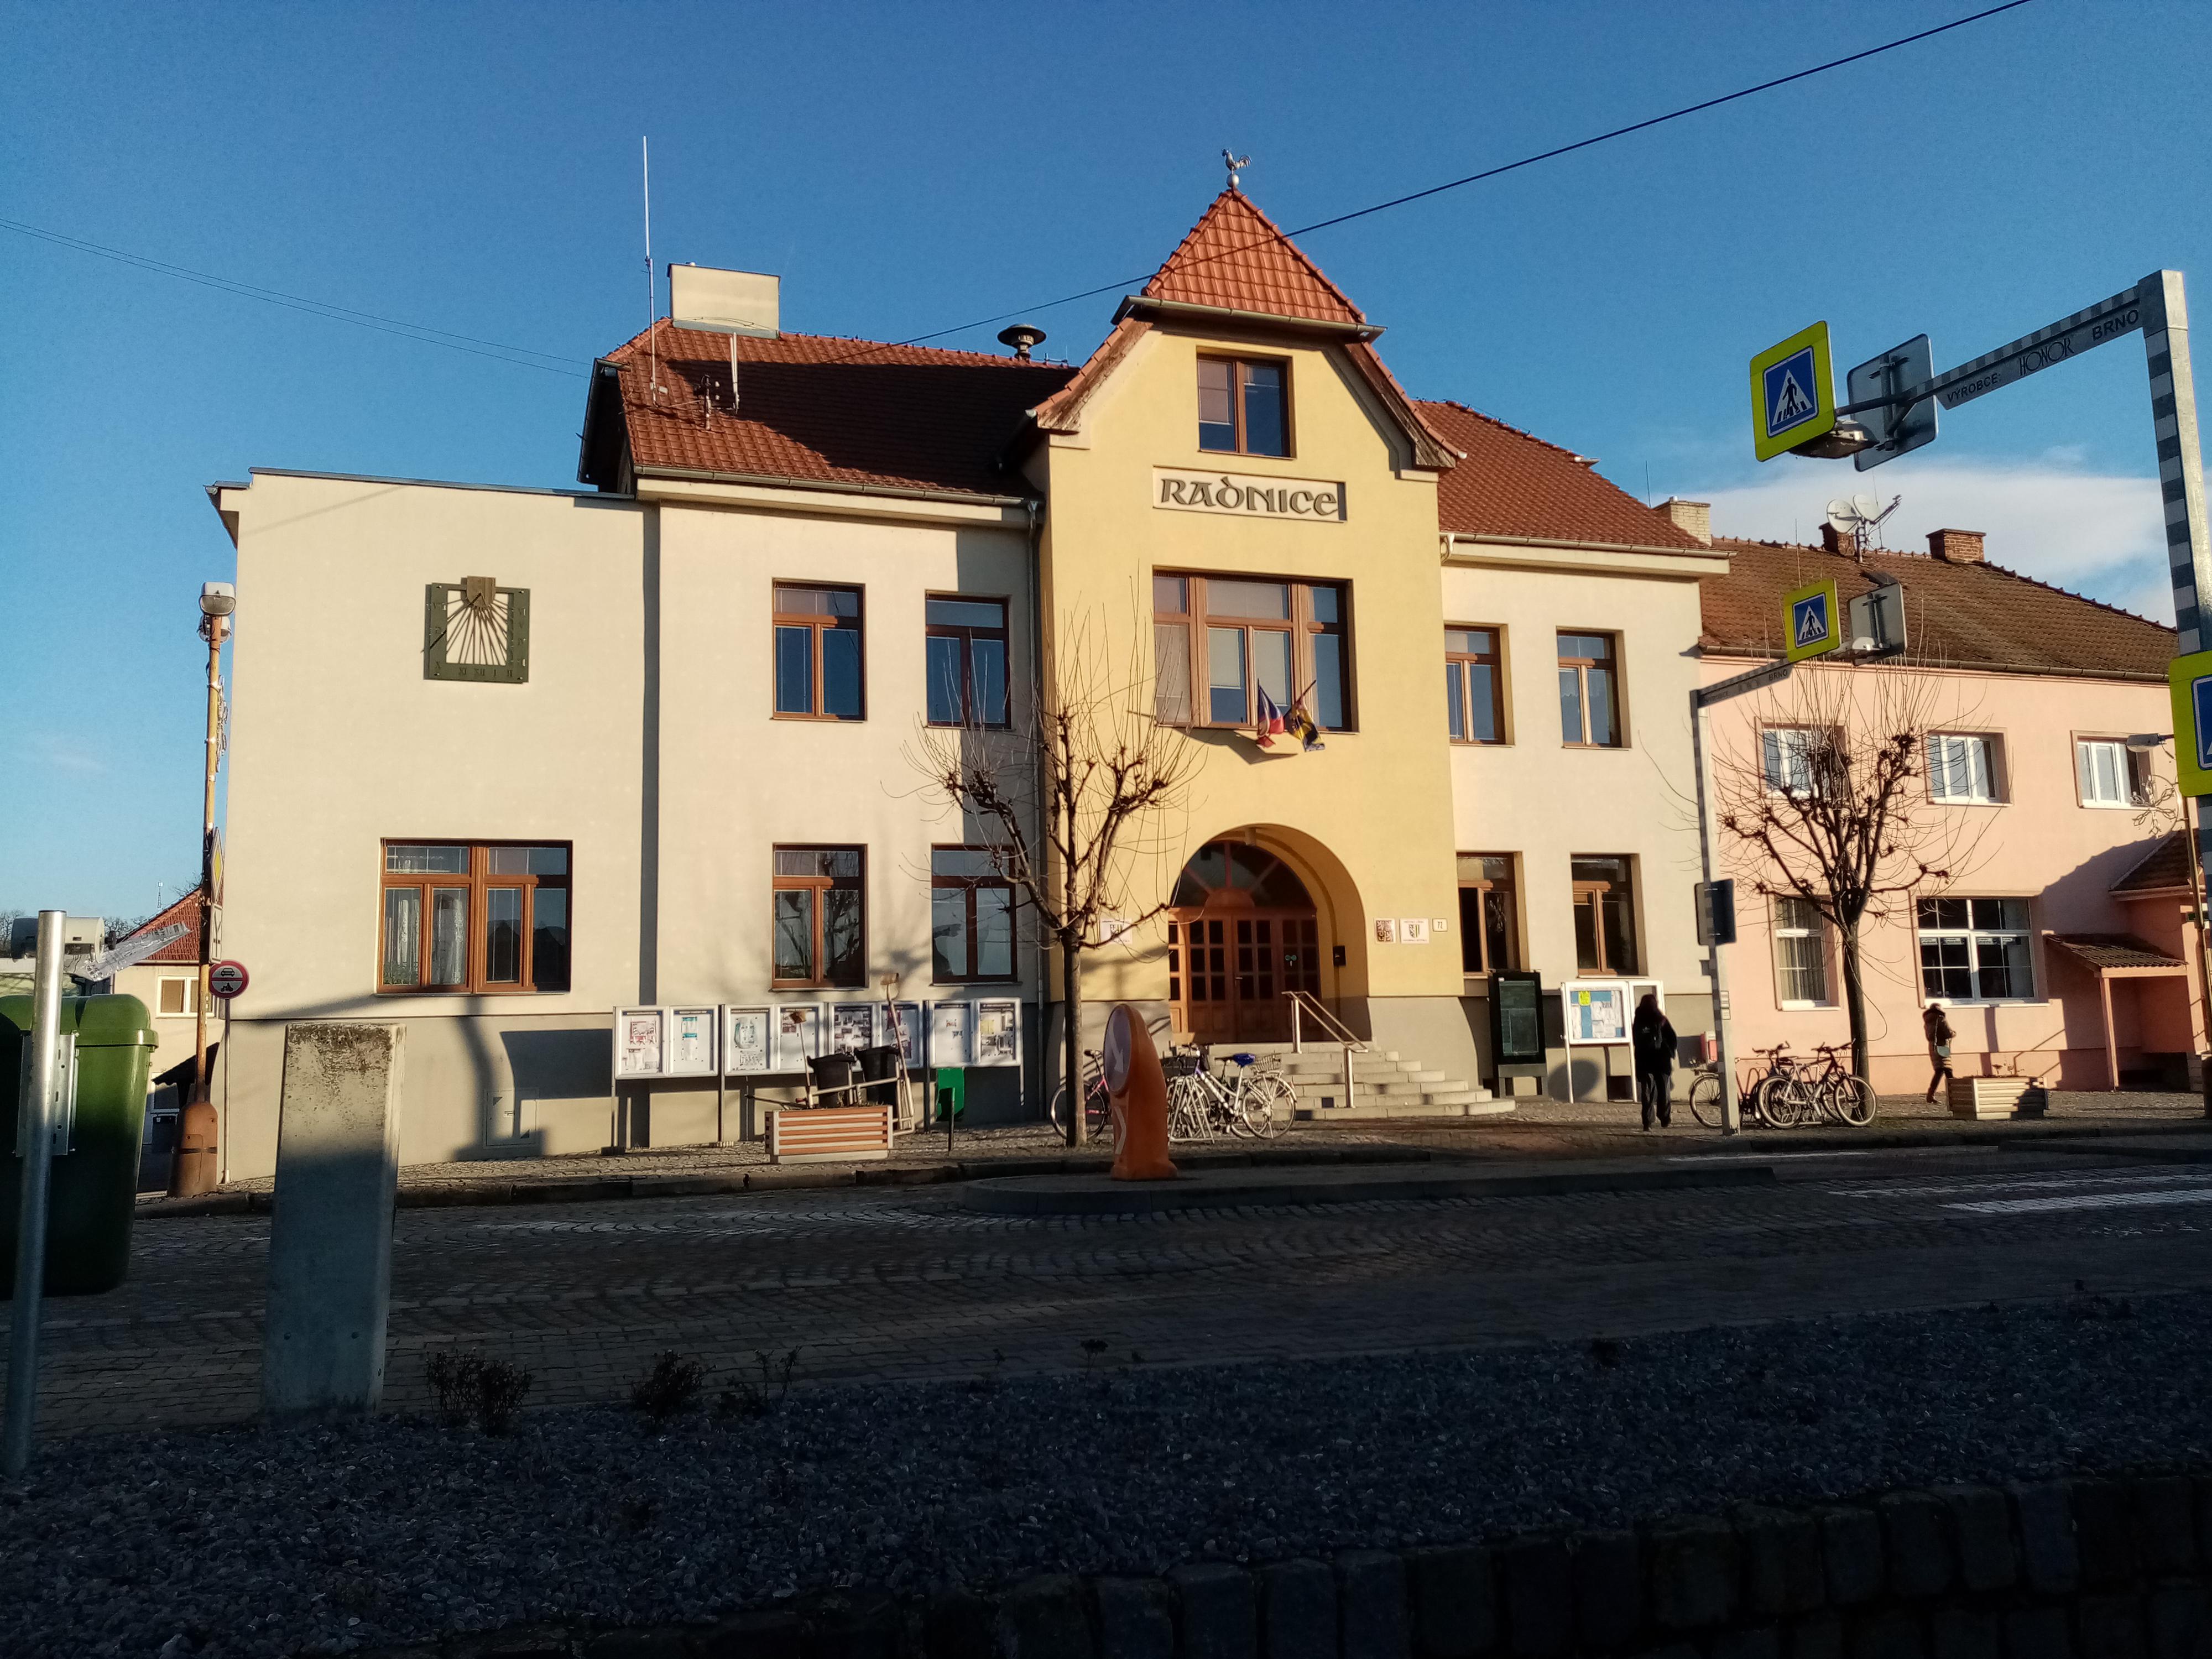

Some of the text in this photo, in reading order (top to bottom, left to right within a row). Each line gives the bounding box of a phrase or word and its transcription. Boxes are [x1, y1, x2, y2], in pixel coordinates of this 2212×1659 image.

[2019, 337, 2074, 376] HONOR
[2093, 309, 2139, 341] BRNO
[1768, 669, 1788, 681] BRNO
